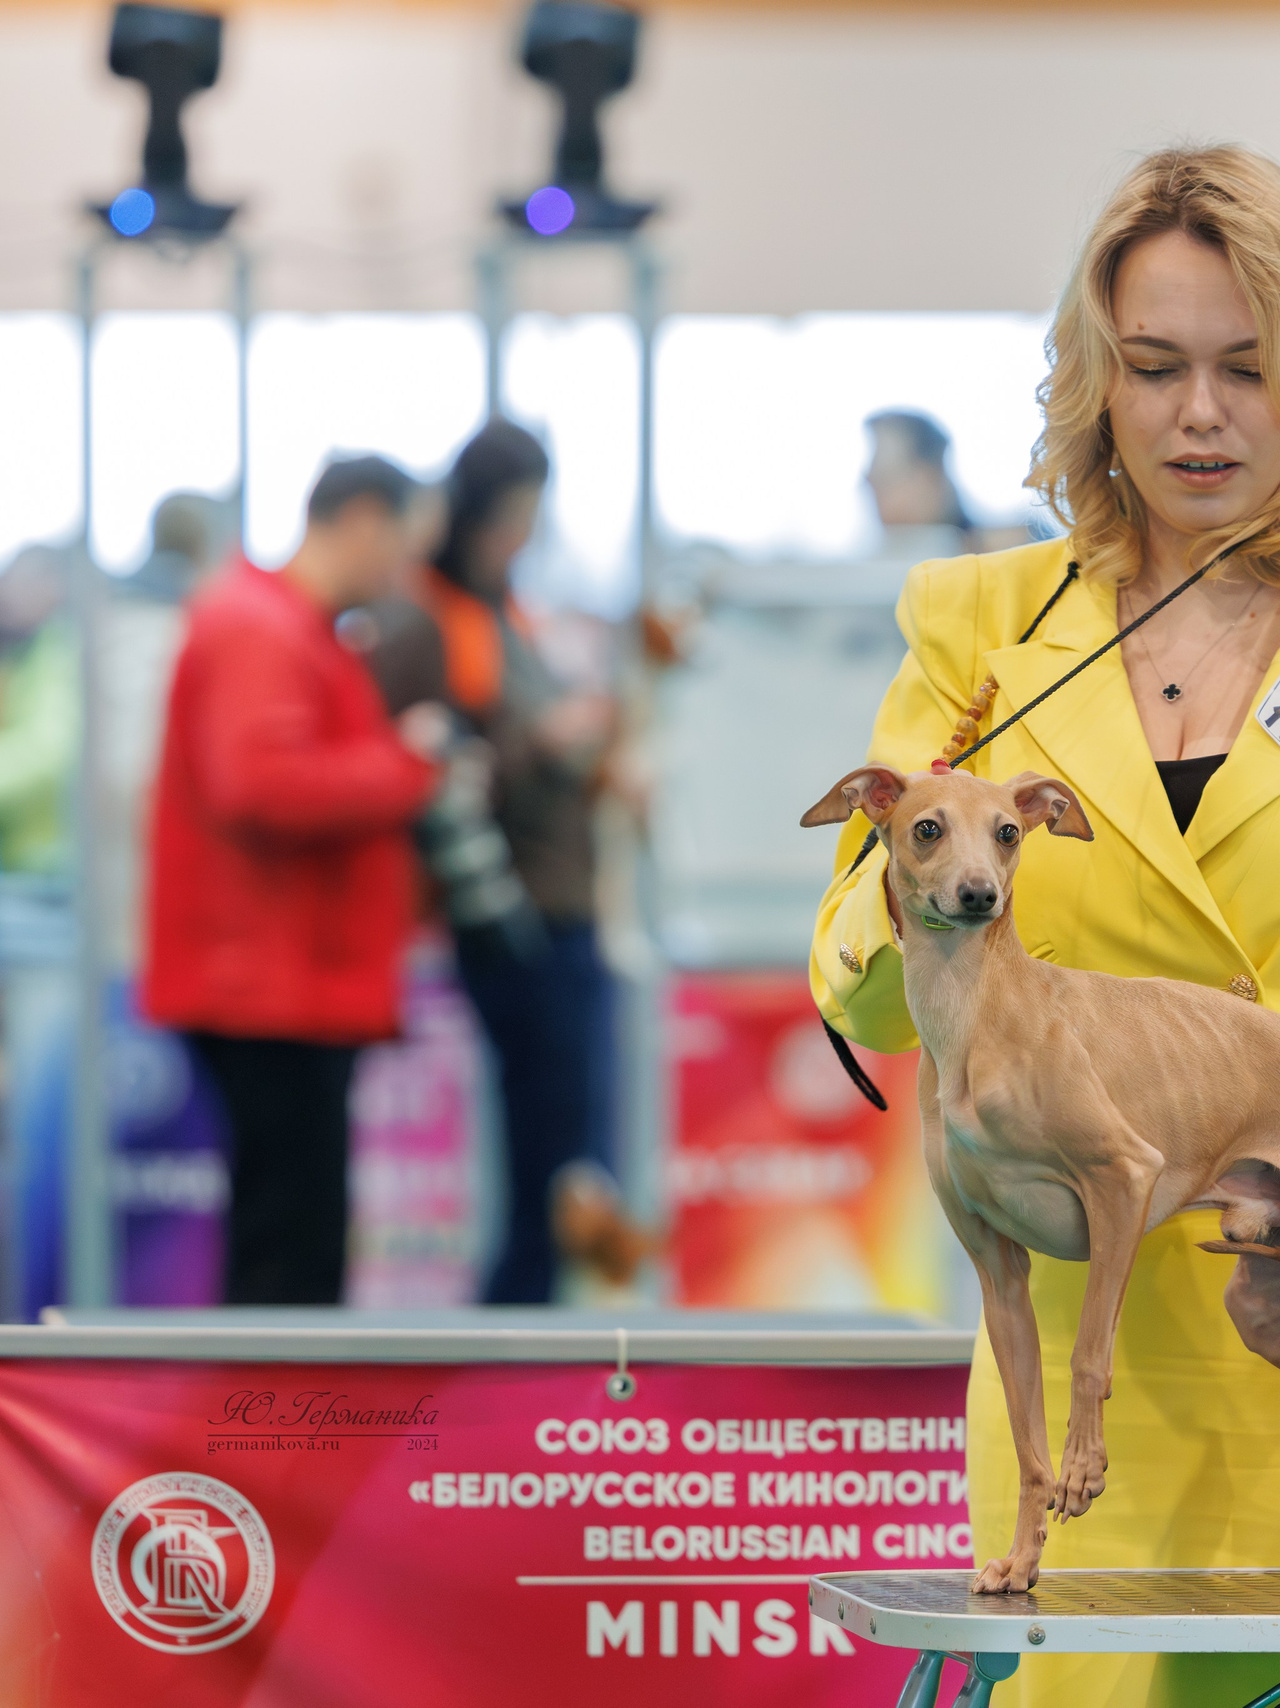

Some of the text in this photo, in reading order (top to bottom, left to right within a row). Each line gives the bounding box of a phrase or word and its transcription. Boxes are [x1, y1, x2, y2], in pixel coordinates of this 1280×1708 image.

[534, 1416, 967, 1459] СОЮЗ ОБЩЕСТВЕНН
[408, 1471, 736, 1508] «БЕЛОРУССКОЕ
[583, 1524, 860, 1561] BELORUSSIAN
